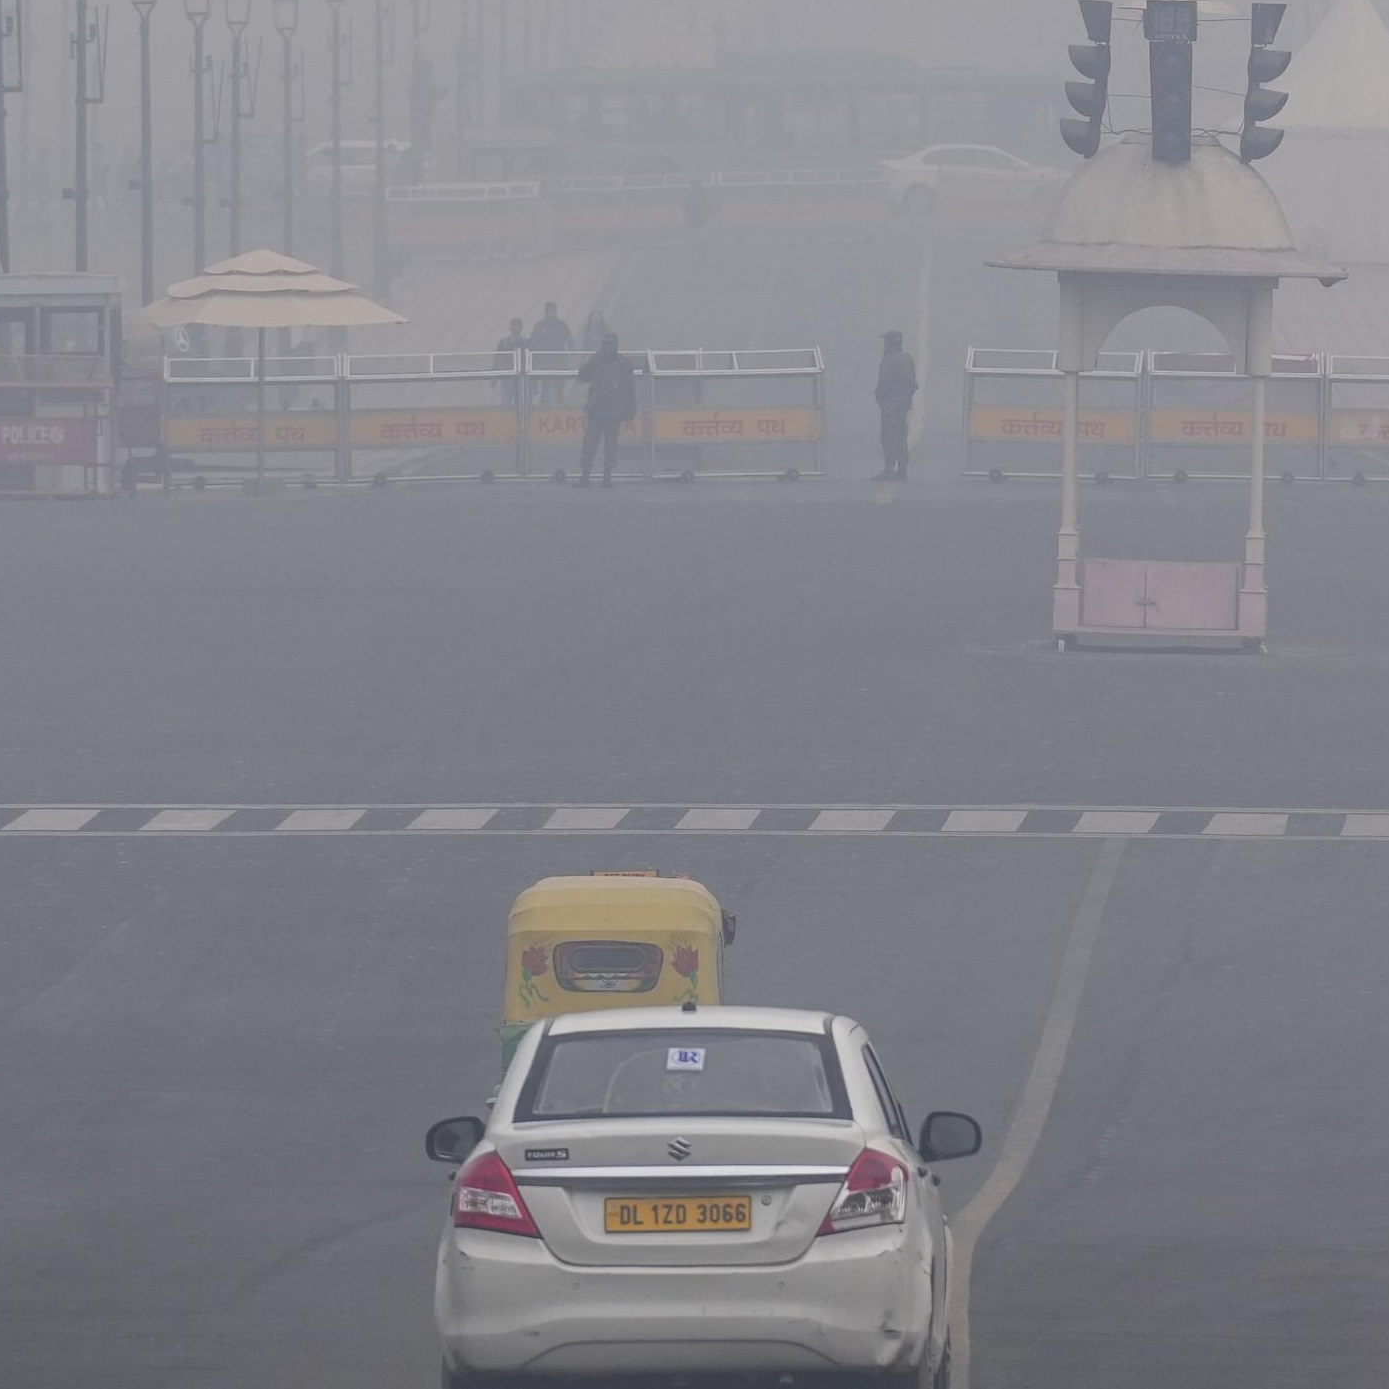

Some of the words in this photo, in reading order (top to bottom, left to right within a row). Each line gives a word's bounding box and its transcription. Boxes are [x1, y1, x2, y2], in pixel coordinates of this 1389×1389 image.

[2, 426, 50, 445] POLICE
[276, 426, 306, 442] पथ
[456, 420, 486, 437] पथ
[757, 419, 786, 435] पथ
[620, 1204, 643, 1225] DL
[651, 1203, 687, 1225] 1ZD
[697, 1202, 747, 1223] 3066
